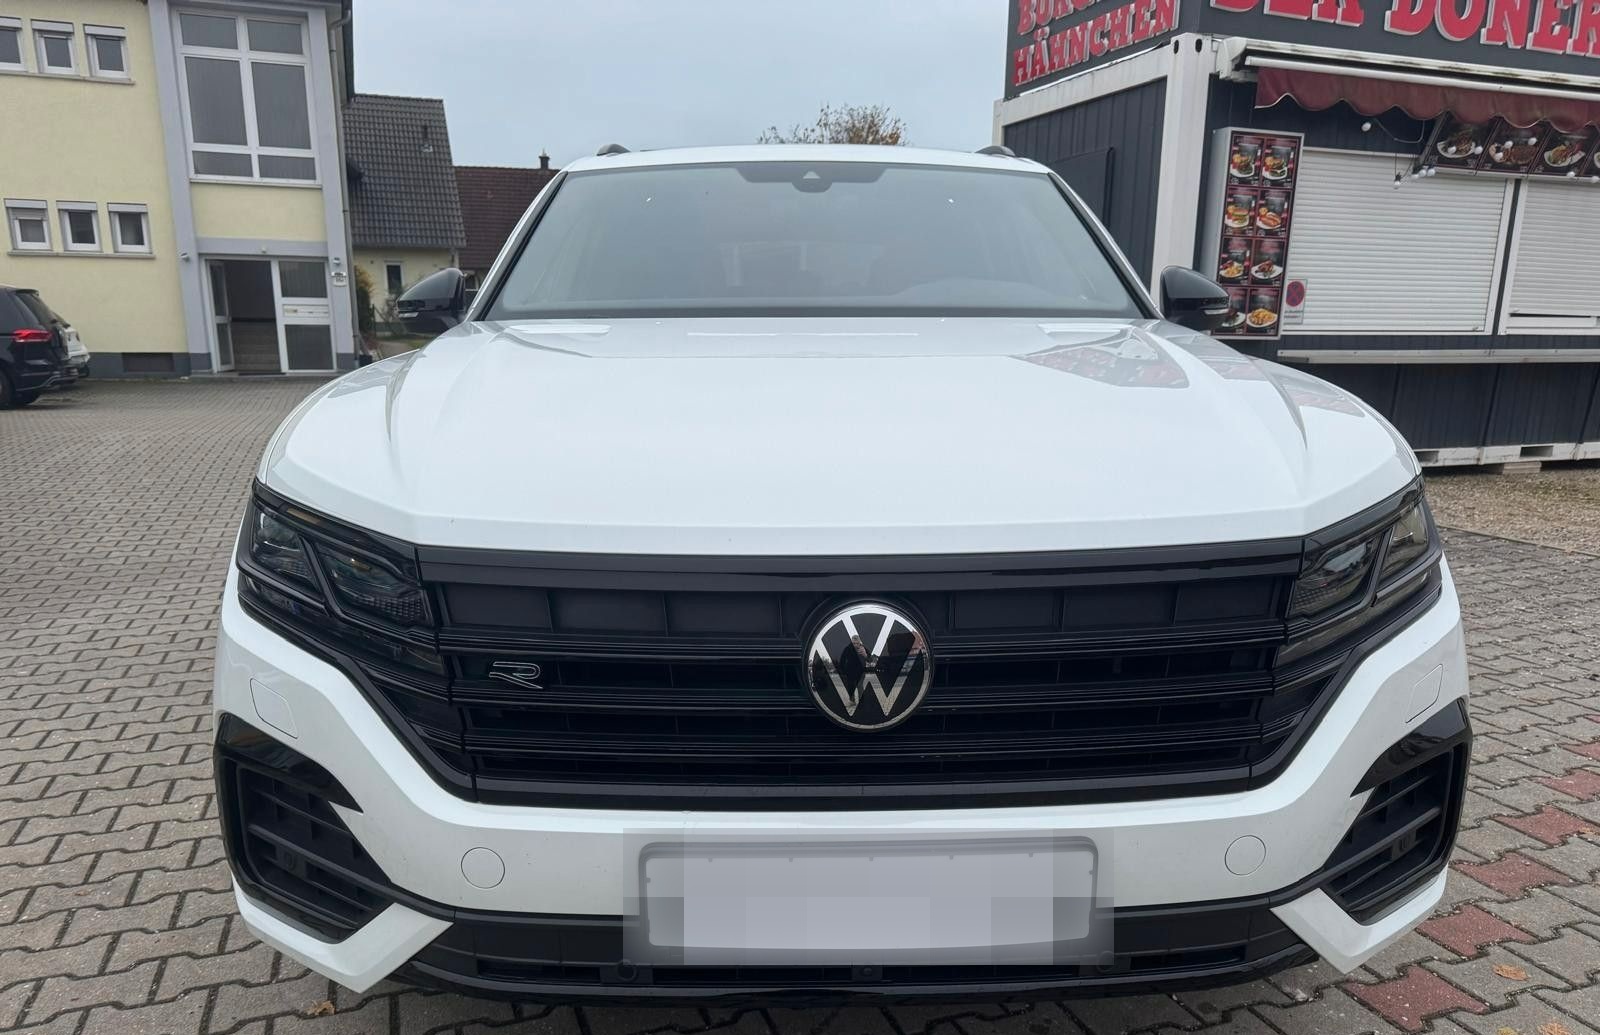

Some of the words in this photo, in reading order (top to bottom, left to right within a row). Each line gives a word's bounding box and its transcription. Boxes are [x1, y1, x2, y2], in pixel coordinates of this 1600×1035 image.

[1013, 0, 1180, 87] HÄHNCHEN
[488, 661, 543, 690] R
[808, 604, 930, 730] VW
